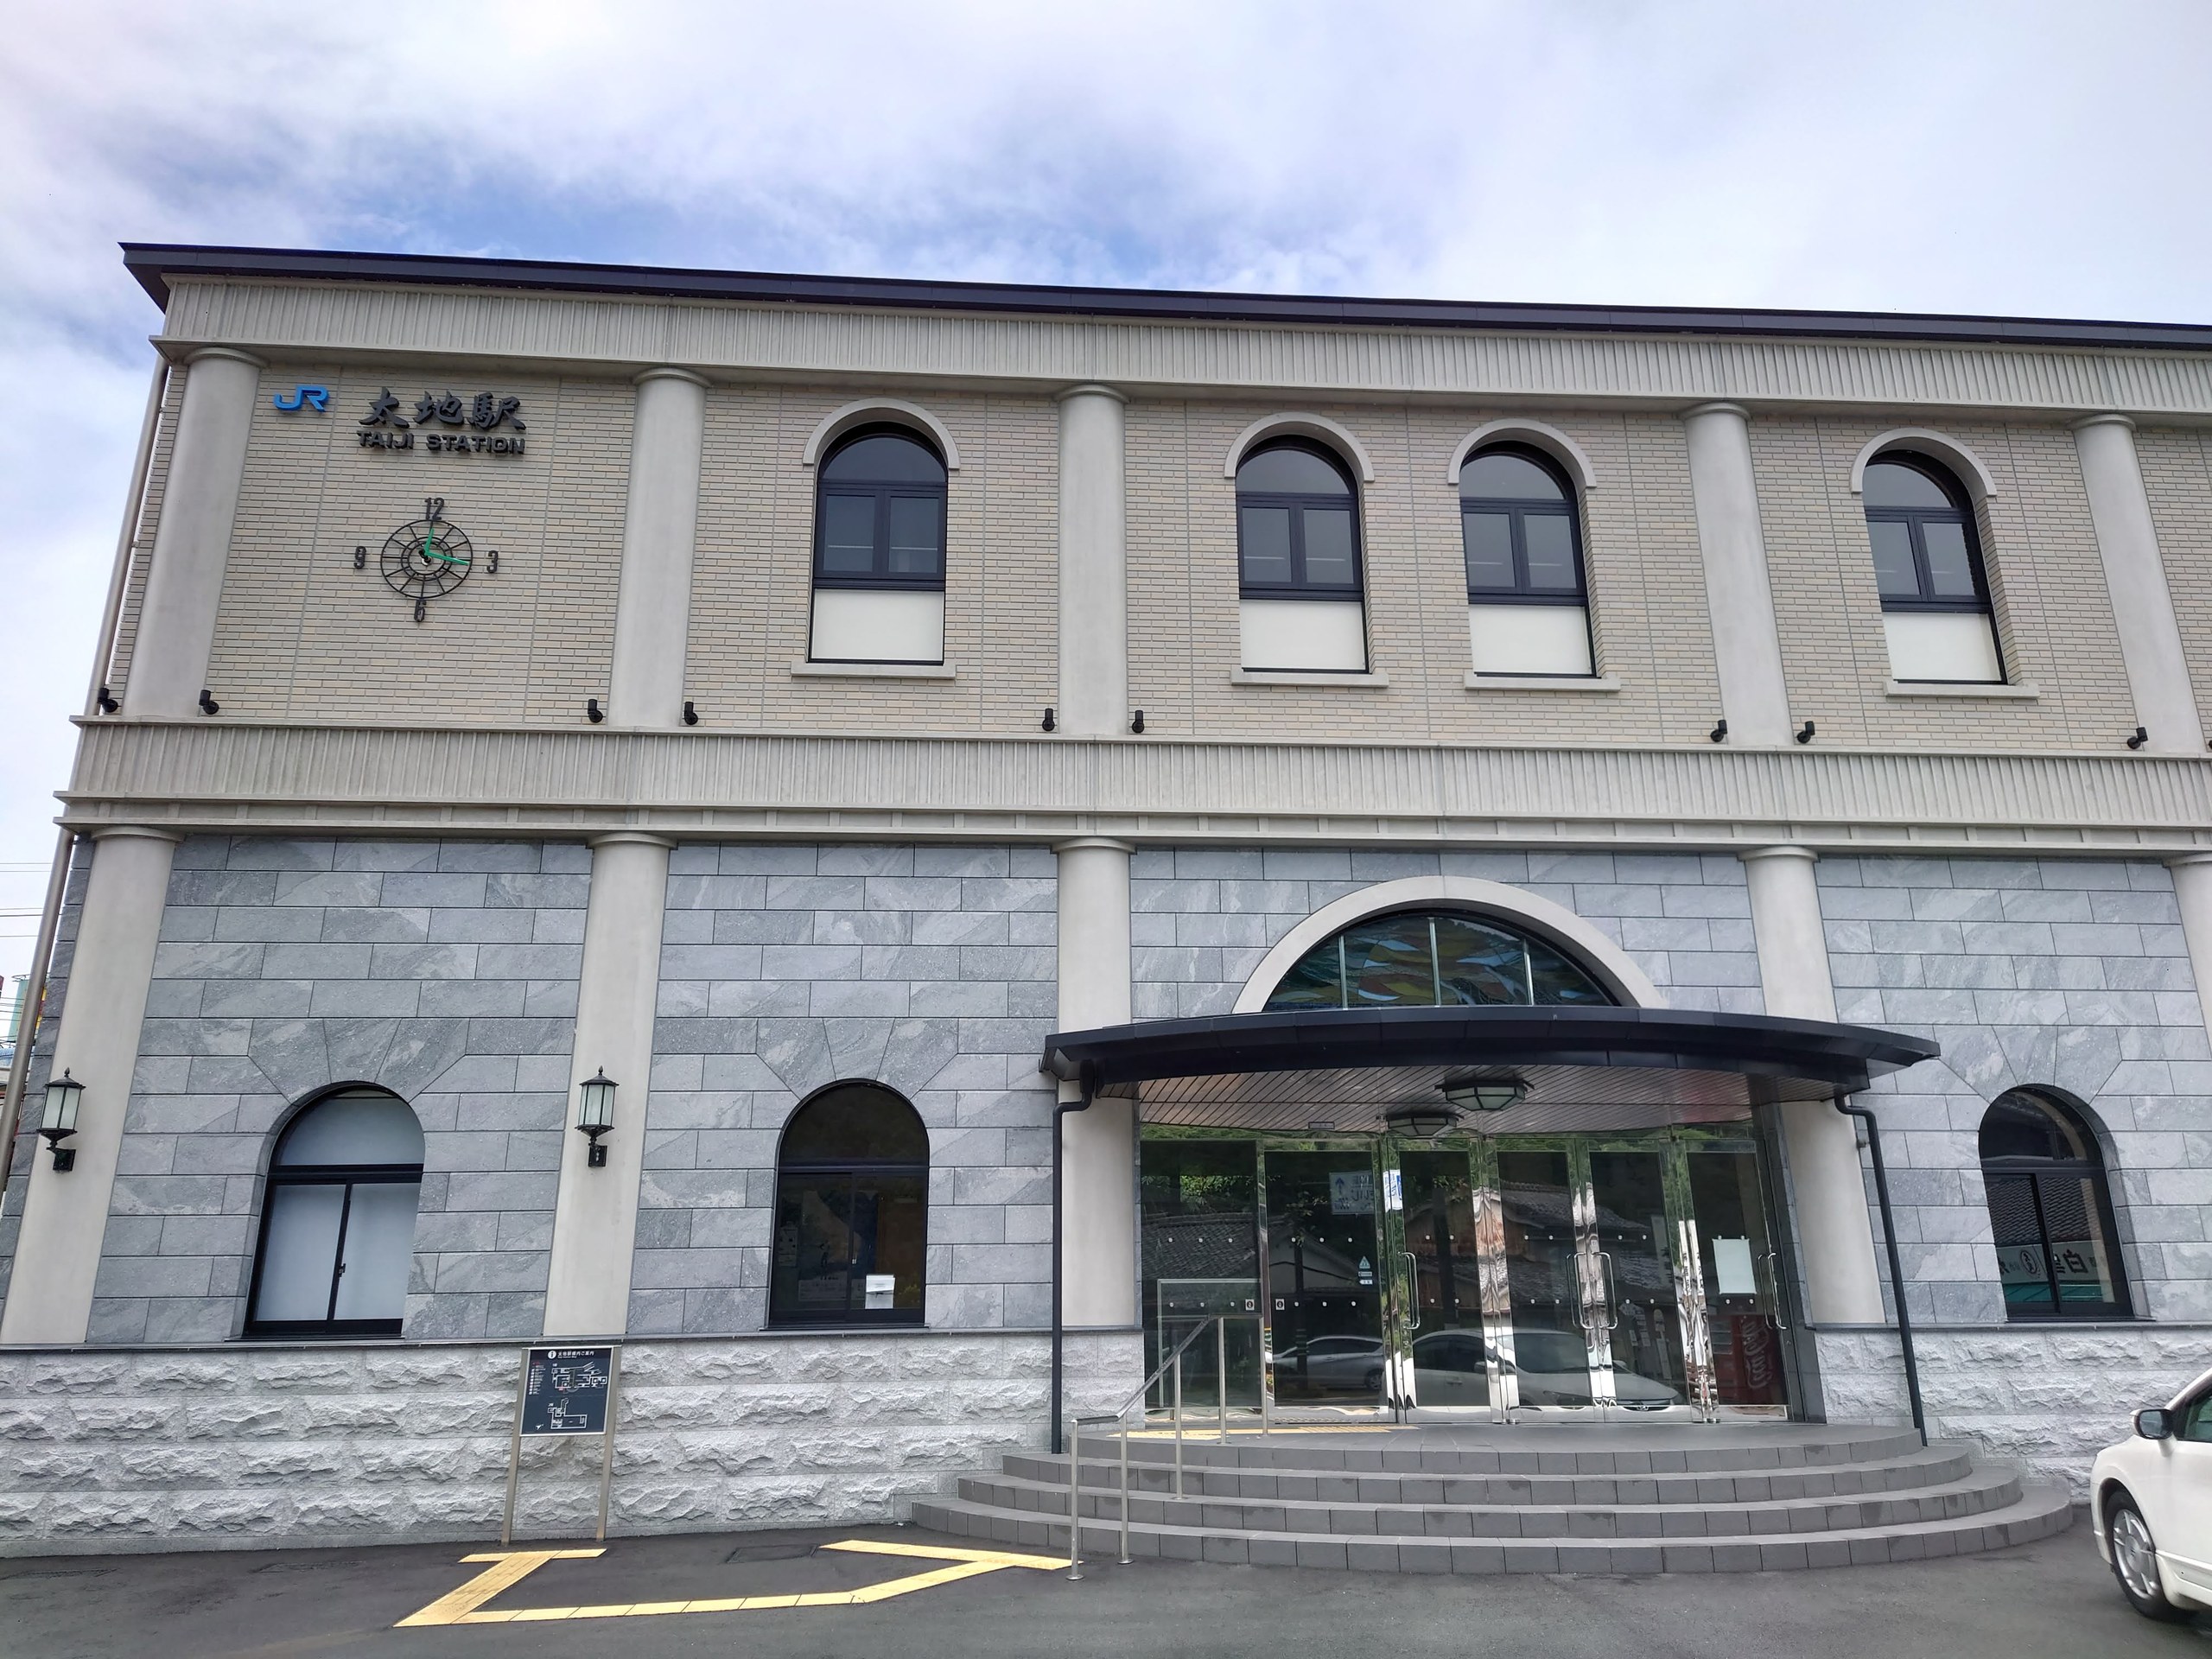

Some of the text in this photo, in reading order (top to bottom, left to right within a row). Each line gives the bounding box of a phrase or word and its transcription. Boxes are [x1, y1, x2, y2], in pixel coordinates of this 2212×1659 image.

[273, 385, 329, 412] JR
[359, 386, 526, 430] 太地駅
[357, 430, 526, 455] TAIJI STATION
[424, 497, 445, 520] 12
[353, 545, 367, 569] 9
[486, 550, 499, 574] 3
[413, 599, 427, 623] 6
